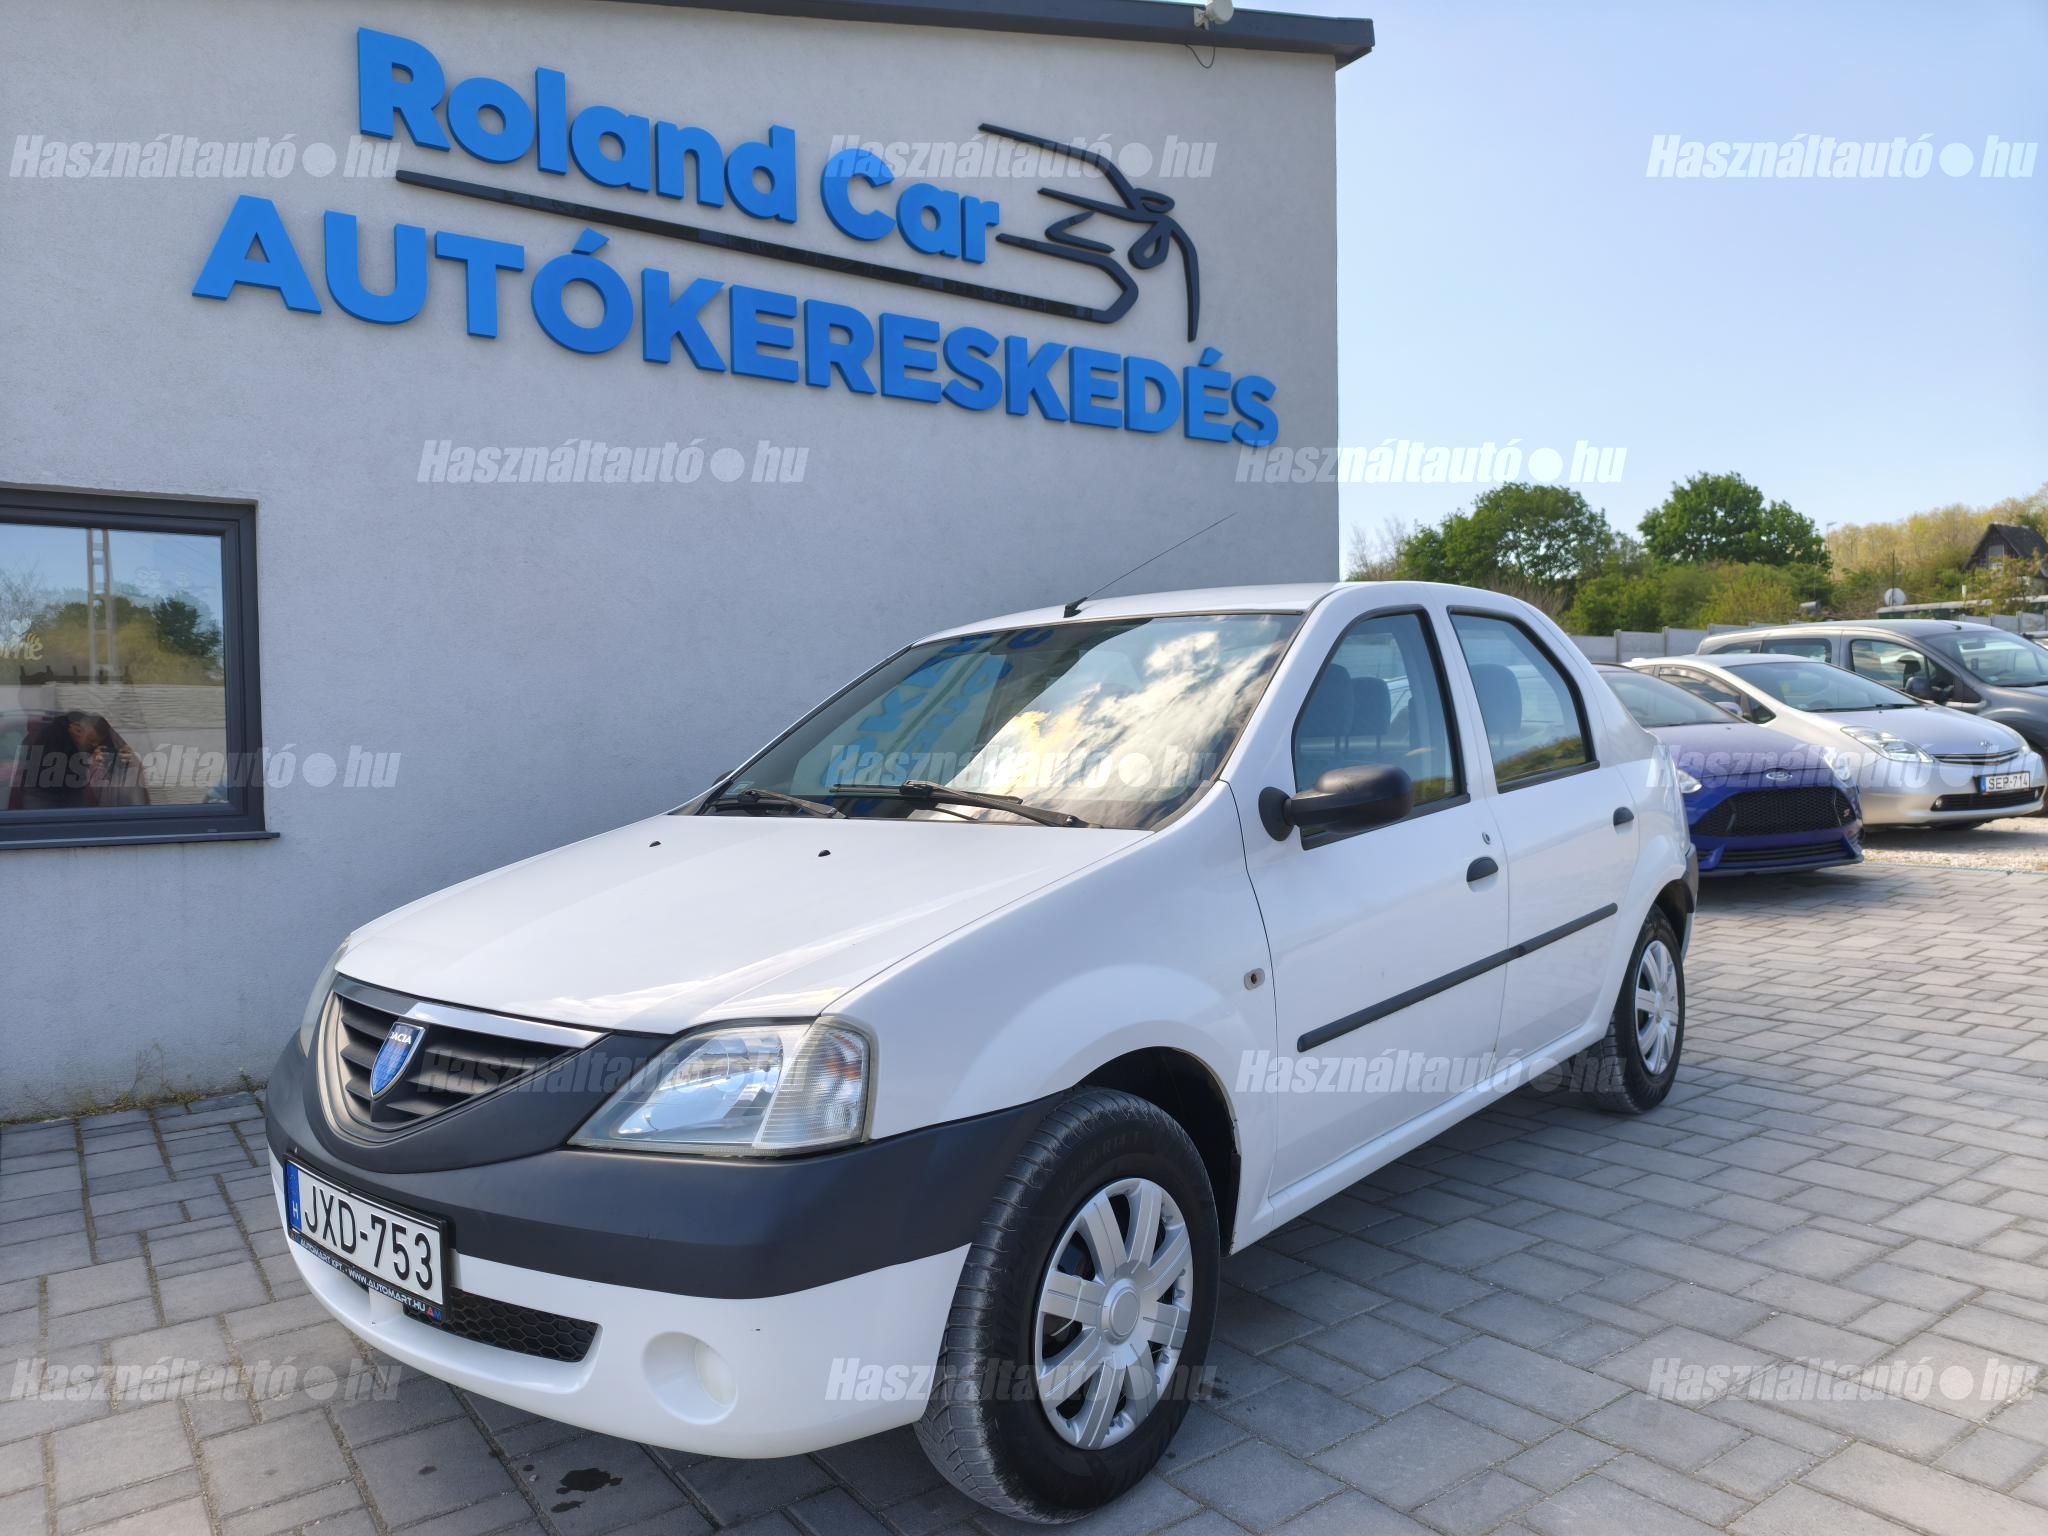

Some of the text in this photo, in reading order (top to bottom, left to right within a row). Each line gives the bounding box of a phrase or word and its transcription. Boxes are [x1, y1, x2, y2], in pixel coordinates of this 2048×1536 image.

[357, 27, 999, 263] Roland Car
[192, 195, 1279, 448] AUTÓKERESKEDÉS
[304, 1185, 433, 1291] JXD-753
